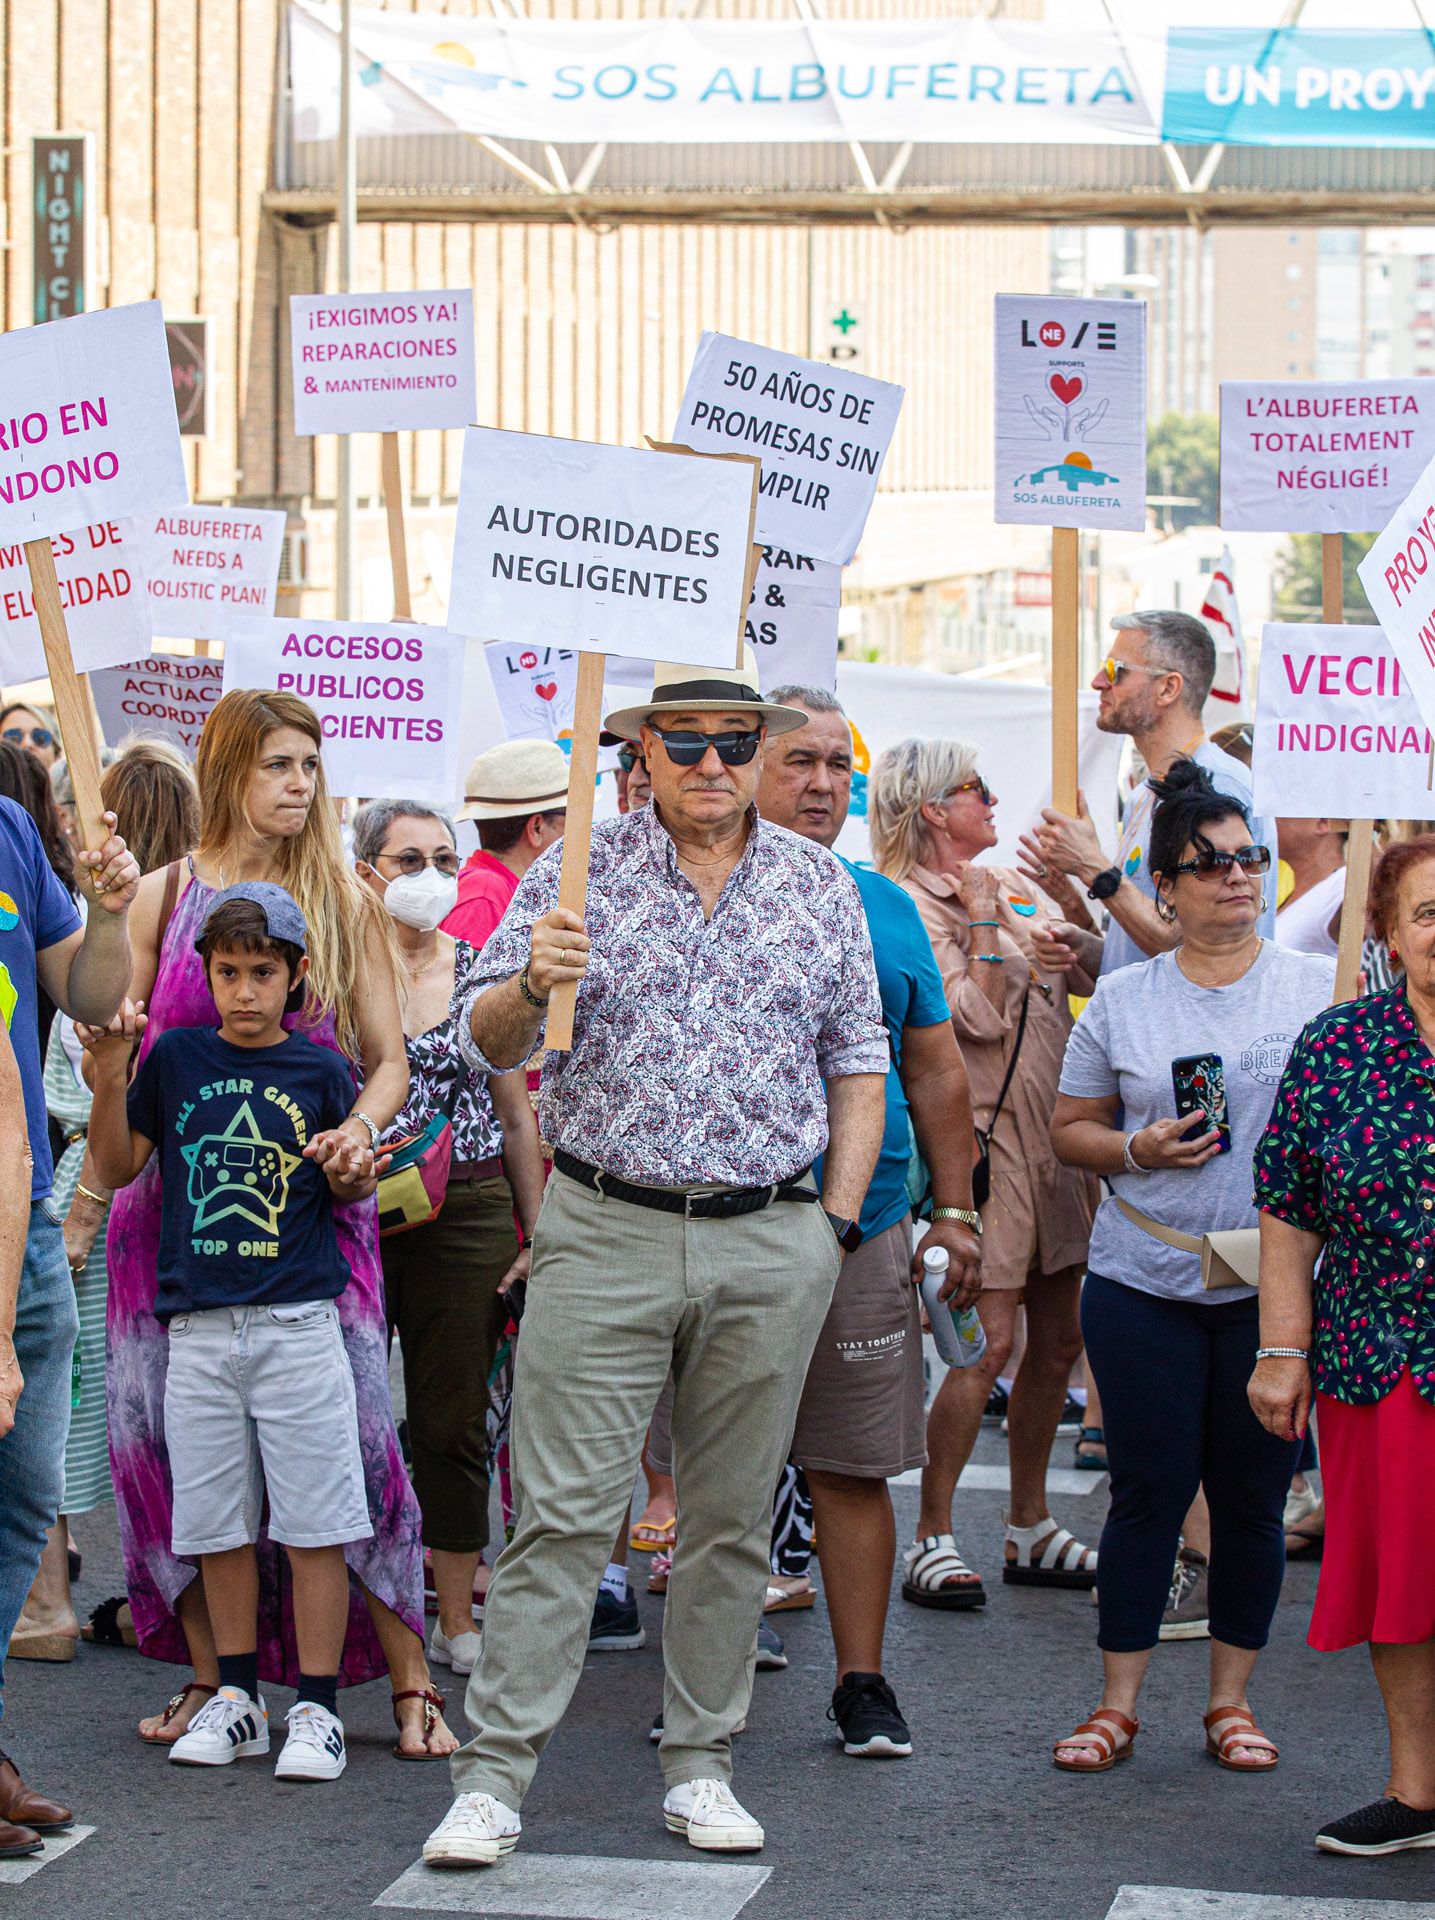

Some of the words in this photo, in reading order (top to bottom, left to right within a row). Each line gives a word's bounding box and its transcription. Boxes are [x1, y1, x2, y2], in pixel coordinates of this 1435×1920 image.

[551, 62, 678, 101] SOS
[1204, 63, 1281, 107] UN
[48, 148, 72, 269] NIGHT
[309, 305, 418, 330] ¡EXIGIMOS
[423, 302, 459, 323] YA!
[302, 338, 457, 363] REPARACIONES
[1048, 360, 1086, 368] SUPPORTS
[303, 376, 319, 395] &
[325, 374, 458, 394] MANTENIMIENTO
[723, 360, 757, 392] 50
[760, 371, 836, 414] AÑOS
[839, 393, 875, 426] DE
[59, 396, 108, 436] EN
[1246, 395, 1419, 418] L'ALBUFERETA
[690, 400, 833, 463] PROMESAS
[835, 442, 880, 476] SIN
[1250, 430, 1415, 452] TOTALEMENT
[1276, 463, 1388, 489] NÉGLIGÉ!
[1013, 493, 1038, 504] SOS
[1040, 495, 1121, 509] ALBUFERETA
[155, 518, 263, 541] ALBUFERETA
[487, 505, 720, 558] AUTORIDADES
[173, 548, 226, 569] NEEDS
[231, 553, 243, 570] A
[492, 552, 708, 604] NEGLIGENTES
[221, 585, 266, 605] PLAN!
[765, 584, 786, 608] &
[282, 633, 423, 662] ACCESOS
[277, 673, 424, 702] PUBLICOS
[1277, 724, 1431, 754] INDIGNA
[175, 1101, 196, 1136] ALL
[199, 1078, 254, 1101] STAR
[191, 1239, 229, 1256] TOP
[237, 1240, 280, 1257] ONE
[836, 1341, 863, 1350] STAY
[866, 1329, 906, 1348] TOGETHER
